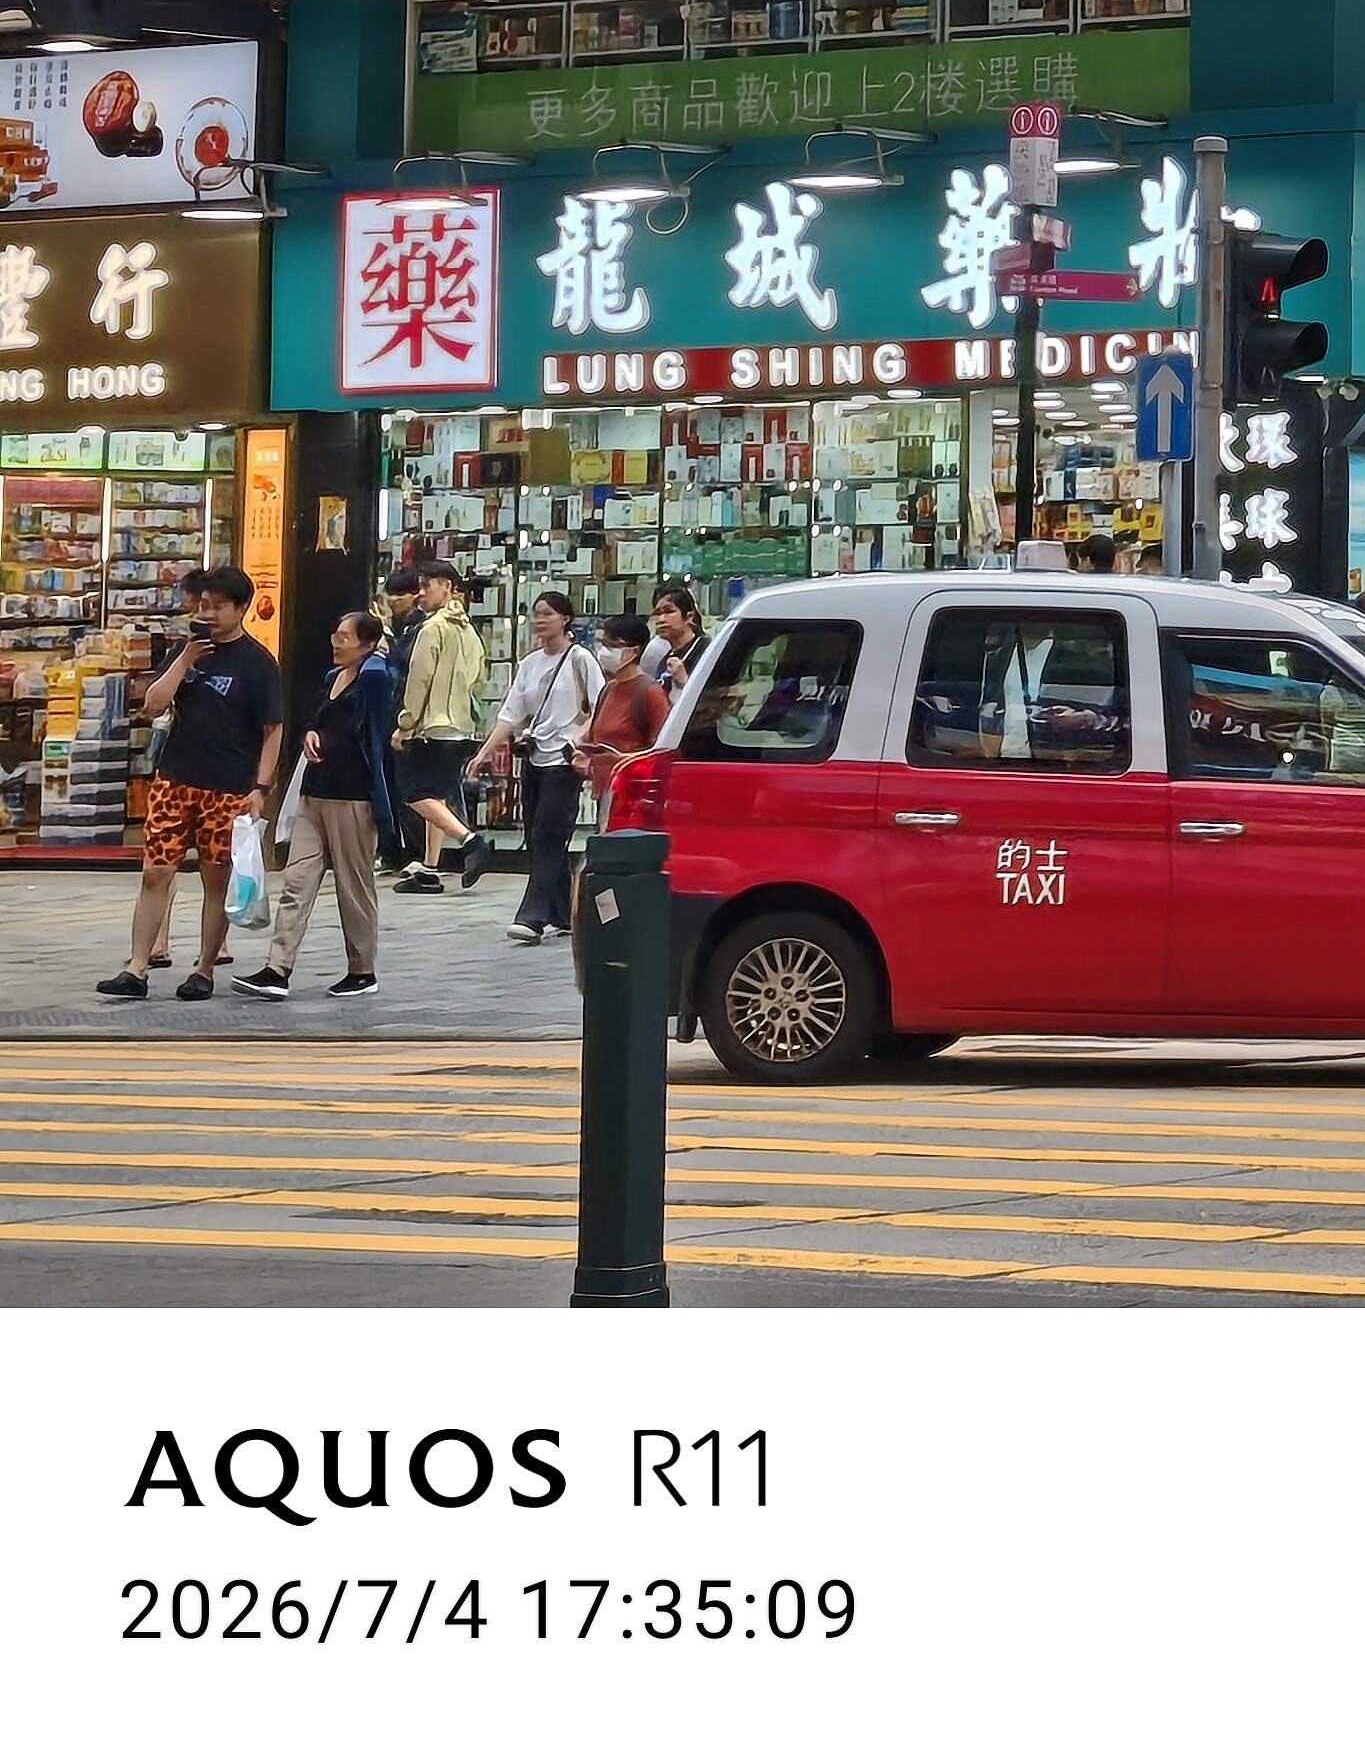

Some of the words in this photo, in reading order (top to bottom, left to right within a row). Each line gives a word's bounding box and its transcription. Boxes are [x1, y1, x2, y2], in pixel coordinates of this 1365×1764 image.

[358, 212, 479, 369] 藥
[67, 362, 167, 401] HONG
[543, 351, 687, 397] LUNG
[730, 343, 908, 392] SHING
[953, 328, 1201, 384] MEDICIN
[997, 839, 1069, 871] 的士
[995, 873, 1066, 905] TAXI
